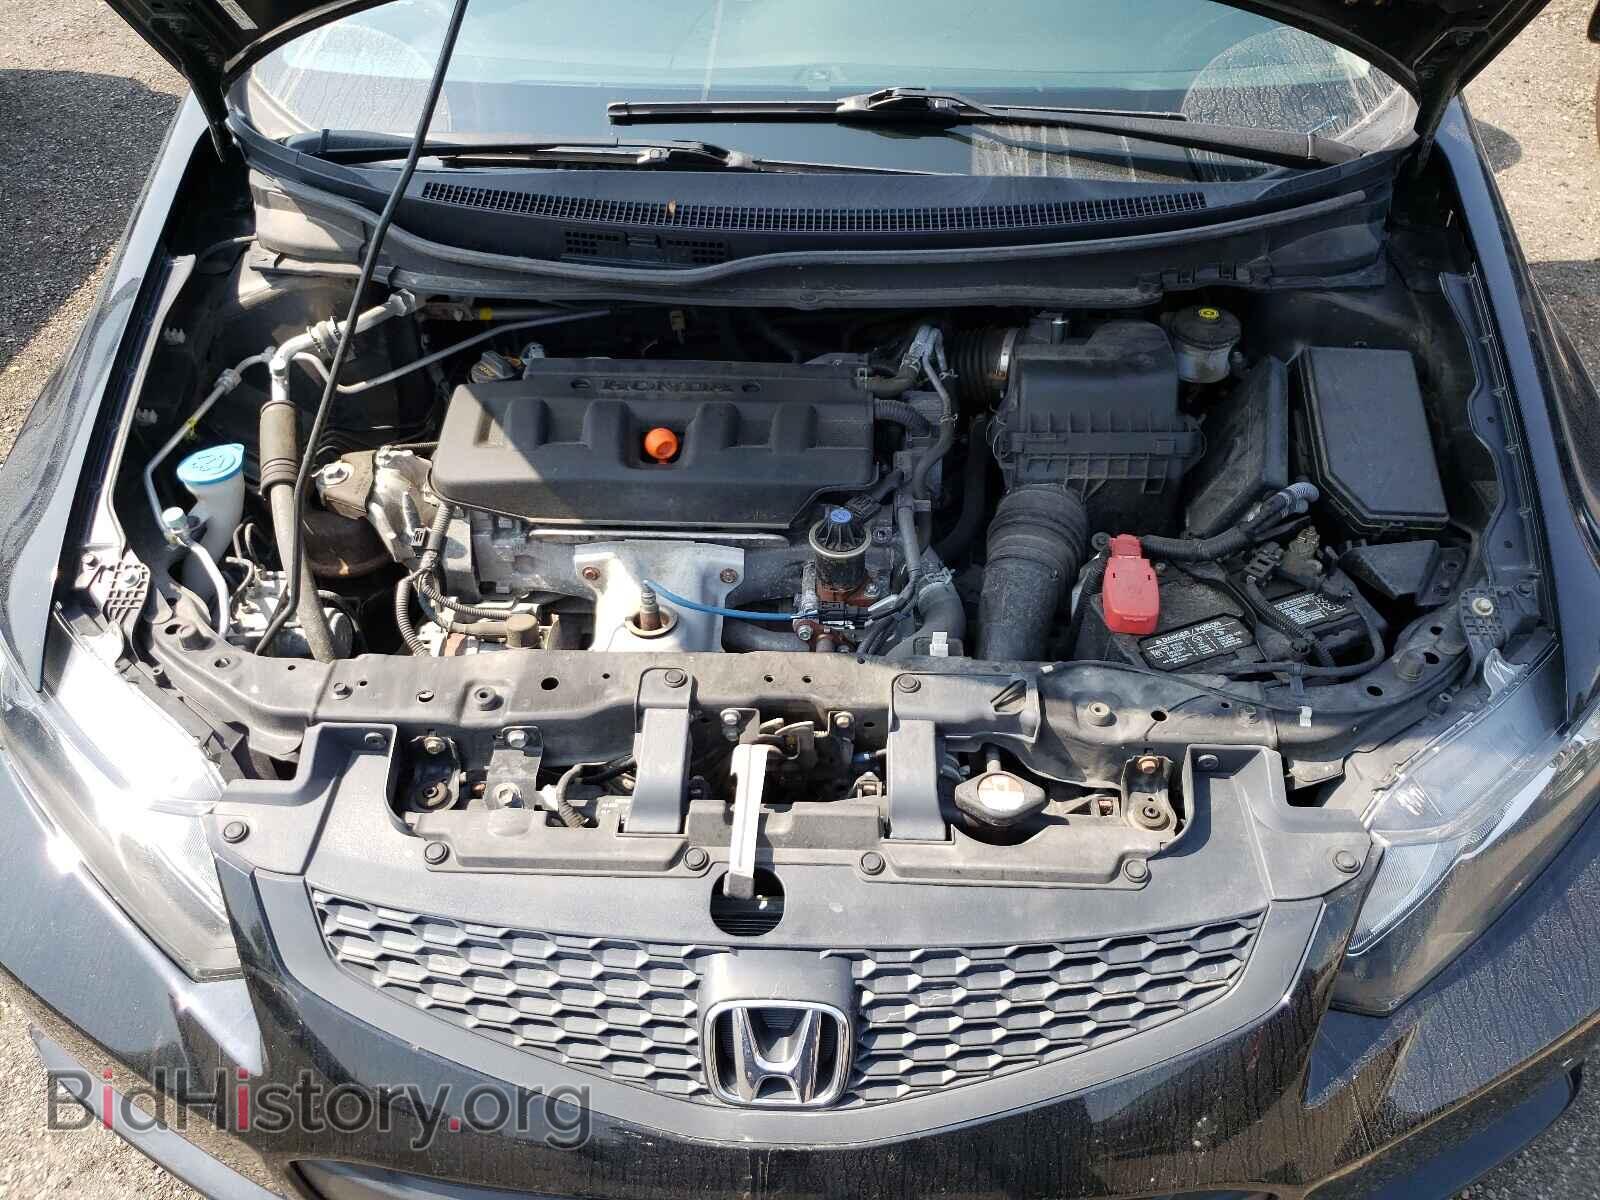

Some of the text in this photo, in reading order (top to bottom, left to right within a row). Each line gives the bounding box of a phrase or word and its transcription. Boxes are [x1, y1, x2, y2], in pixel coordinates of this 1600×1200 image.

[600, 377, 736, 393] HONDA
[1161, 630, 1190, 643] DANGER
[1194, 621, 1221, 633] POISON
